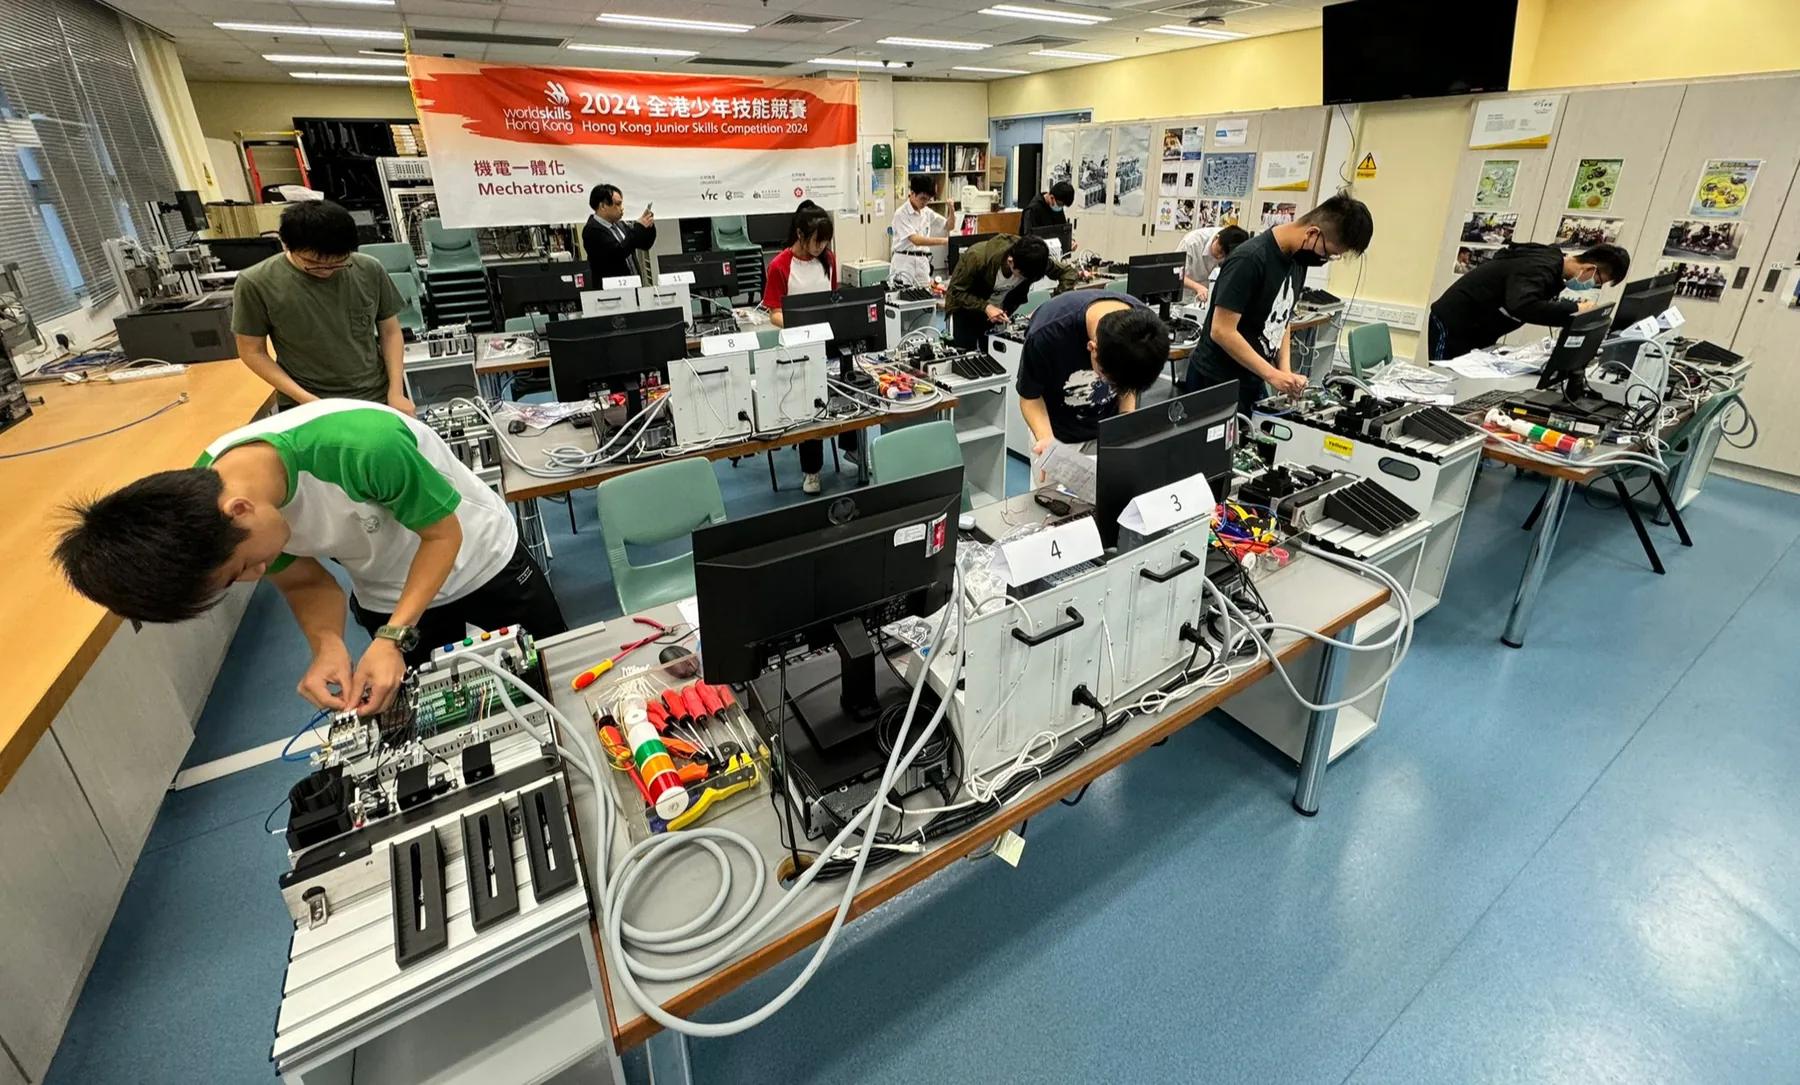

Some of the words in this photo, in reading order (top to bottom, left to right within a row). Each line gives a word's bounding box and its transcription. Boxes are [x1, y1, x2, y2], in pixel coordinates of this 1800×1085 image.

[503, 107, 572, 120] worldskills
[579, 92, 641, 116] 2024
[646, 94, 807, 120] 全港少年技能競賽
[505, 118, 540, 134] Hong
[542, 120, 574, 134] Kong
[582, 121, 617, 135] Hong
[620, 121, 651, 136] Kong
[655, 122, 689, 134] Junior
[692, 122, 718, 134] Skills
[721, 122, 784, 136] Competition
[786, 123, 808, 134] 2024
[473, 160, 565, 177] 機電一體化
[478, 181, 584, 196] Mechatronics
[804, 330, 811, 340] 7
[727, 338, 735, 348] 8
[1170, 494, 1182, 512] 3
[1050, 539, 1062, 560] 4
